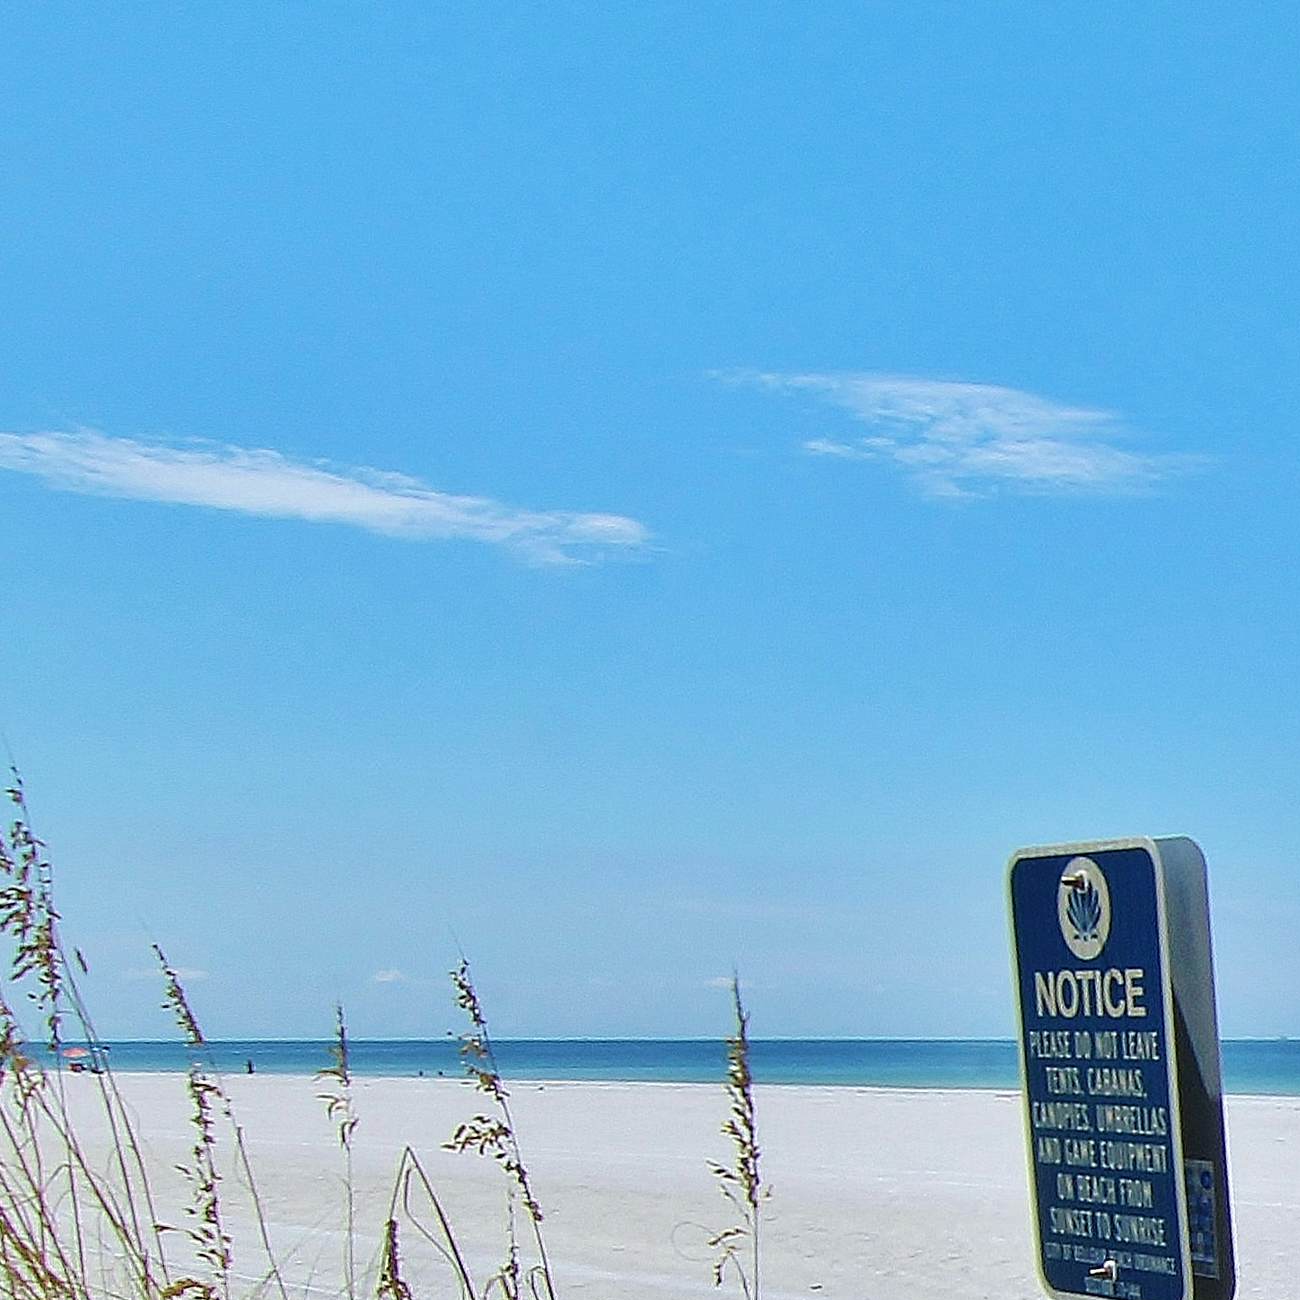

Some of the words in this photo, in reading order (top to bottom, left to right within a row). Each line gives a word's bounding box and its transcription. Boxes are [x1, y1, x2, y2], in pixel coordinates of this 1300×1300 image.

[1034, 968, 1147, 1018] NOTICE
[1029, 1030, 1071, 1058] PLEASE
[1074, 1030, 1091, 1059] DO
[1094, 1030, 1117, 1059] NOT
[1121, 1031, 1160, 1060] LEAVE
[1096, 1104, 1167, 1135] UMBRELLAS
[1038, 1137, 1061, 1164] AND
[1065, 1138, 1098, 1167] GAME
[1101, 1140, 1167, 1173] EQUIPMENT
[1057, 1172, 1074, 1200] ON
[1077, 1174, 1116, 1204] BEACH
[1120, 1178, 1153, 1208] FROM
[1050, 1207, 1093, 1237] SUNSET
[1095, 1211, 1111, 1239] TO
[1114, 1214, 1167, 1247] SUNRISE
